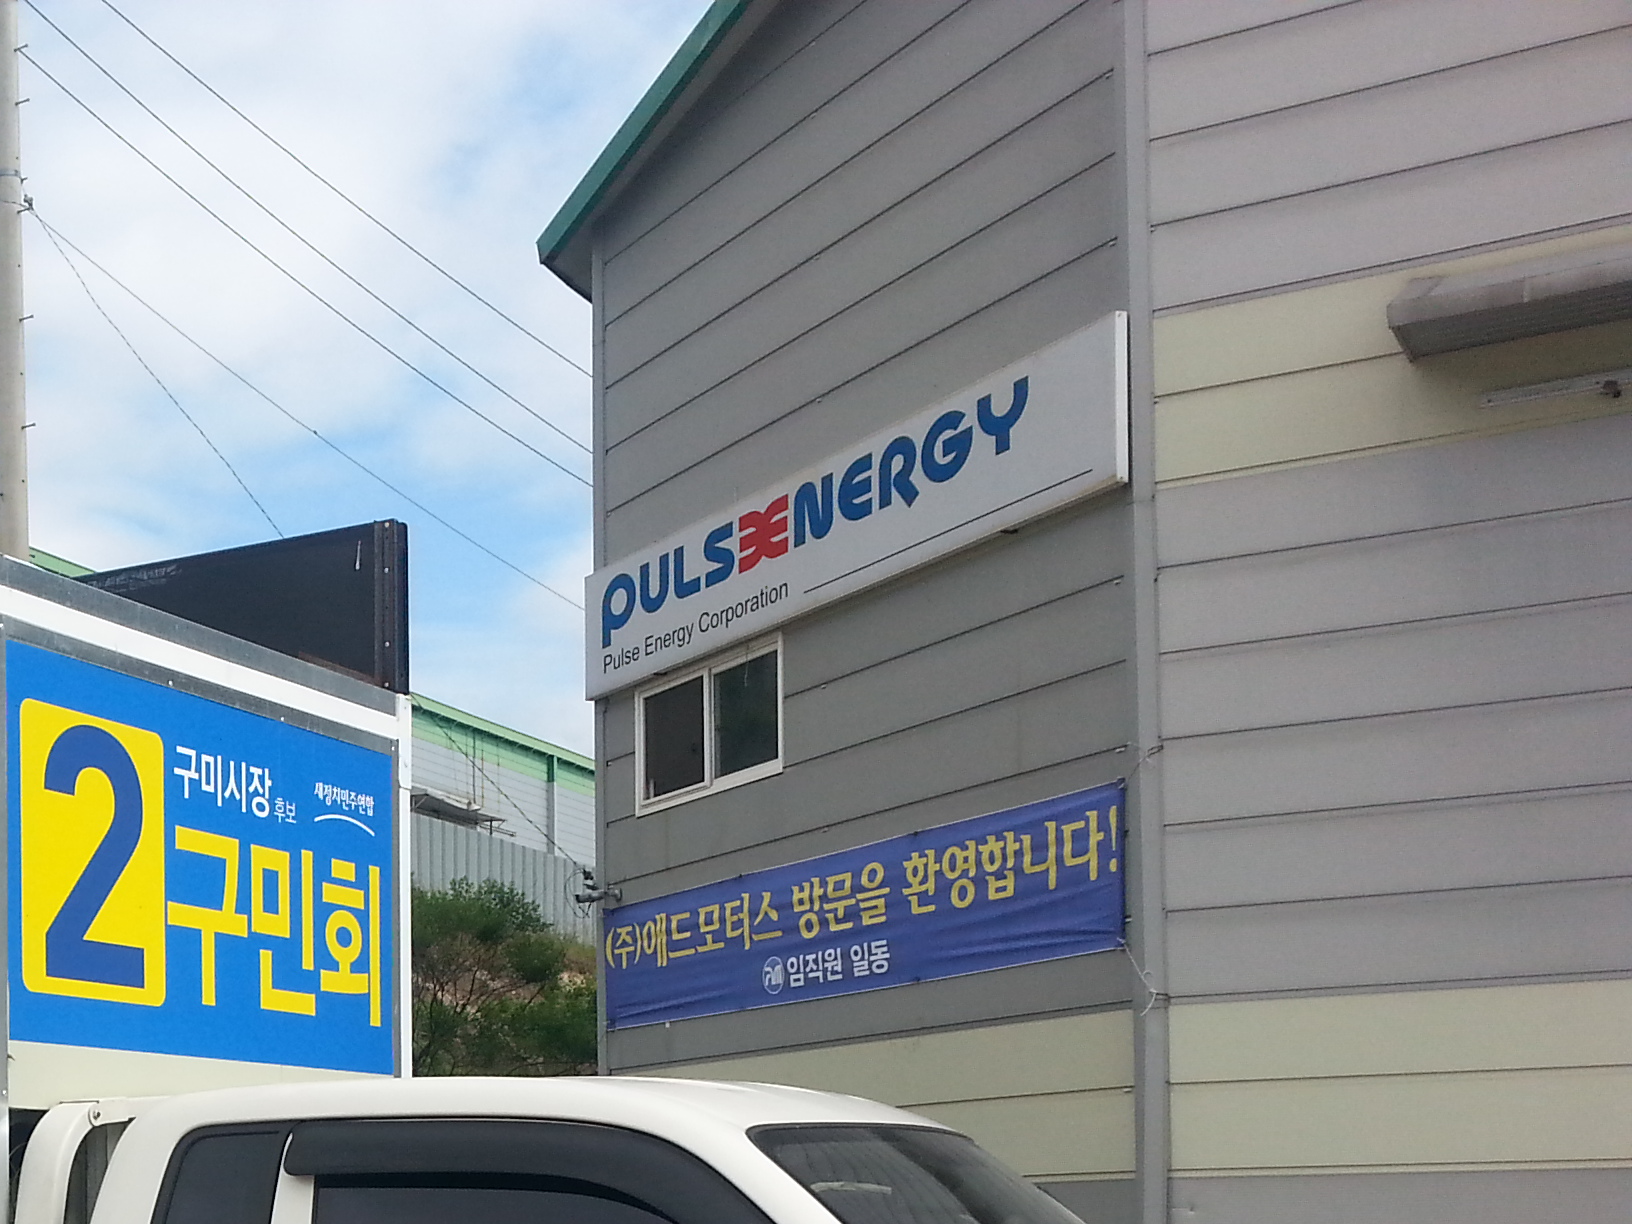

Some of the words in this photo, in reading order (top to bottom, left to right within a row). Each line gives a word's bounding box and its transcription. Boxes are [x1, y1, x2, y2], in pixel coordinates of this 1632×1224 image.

[603, 647, 640, 675] Pulse
[644, 621, 695, 657] Energy
[698, 582, 789, 634] Corporation
[173, 745, 273, 818] 구미시장
[273, 797, 298, 824] 후보
[313, 781, 376, 817] 새정치민주연합
[43, 724, 146, 990] 2
[167, 824, 382, 1028] 구민회
[605, 891, 784, 970] (주)애드모터스
[792, 861, 889, 940] 방문을
[902, 805, 1118, 916] 환영합니다!
[786, 947, 844, 988] 임직원
[849, 939, 891, 978] 일동
